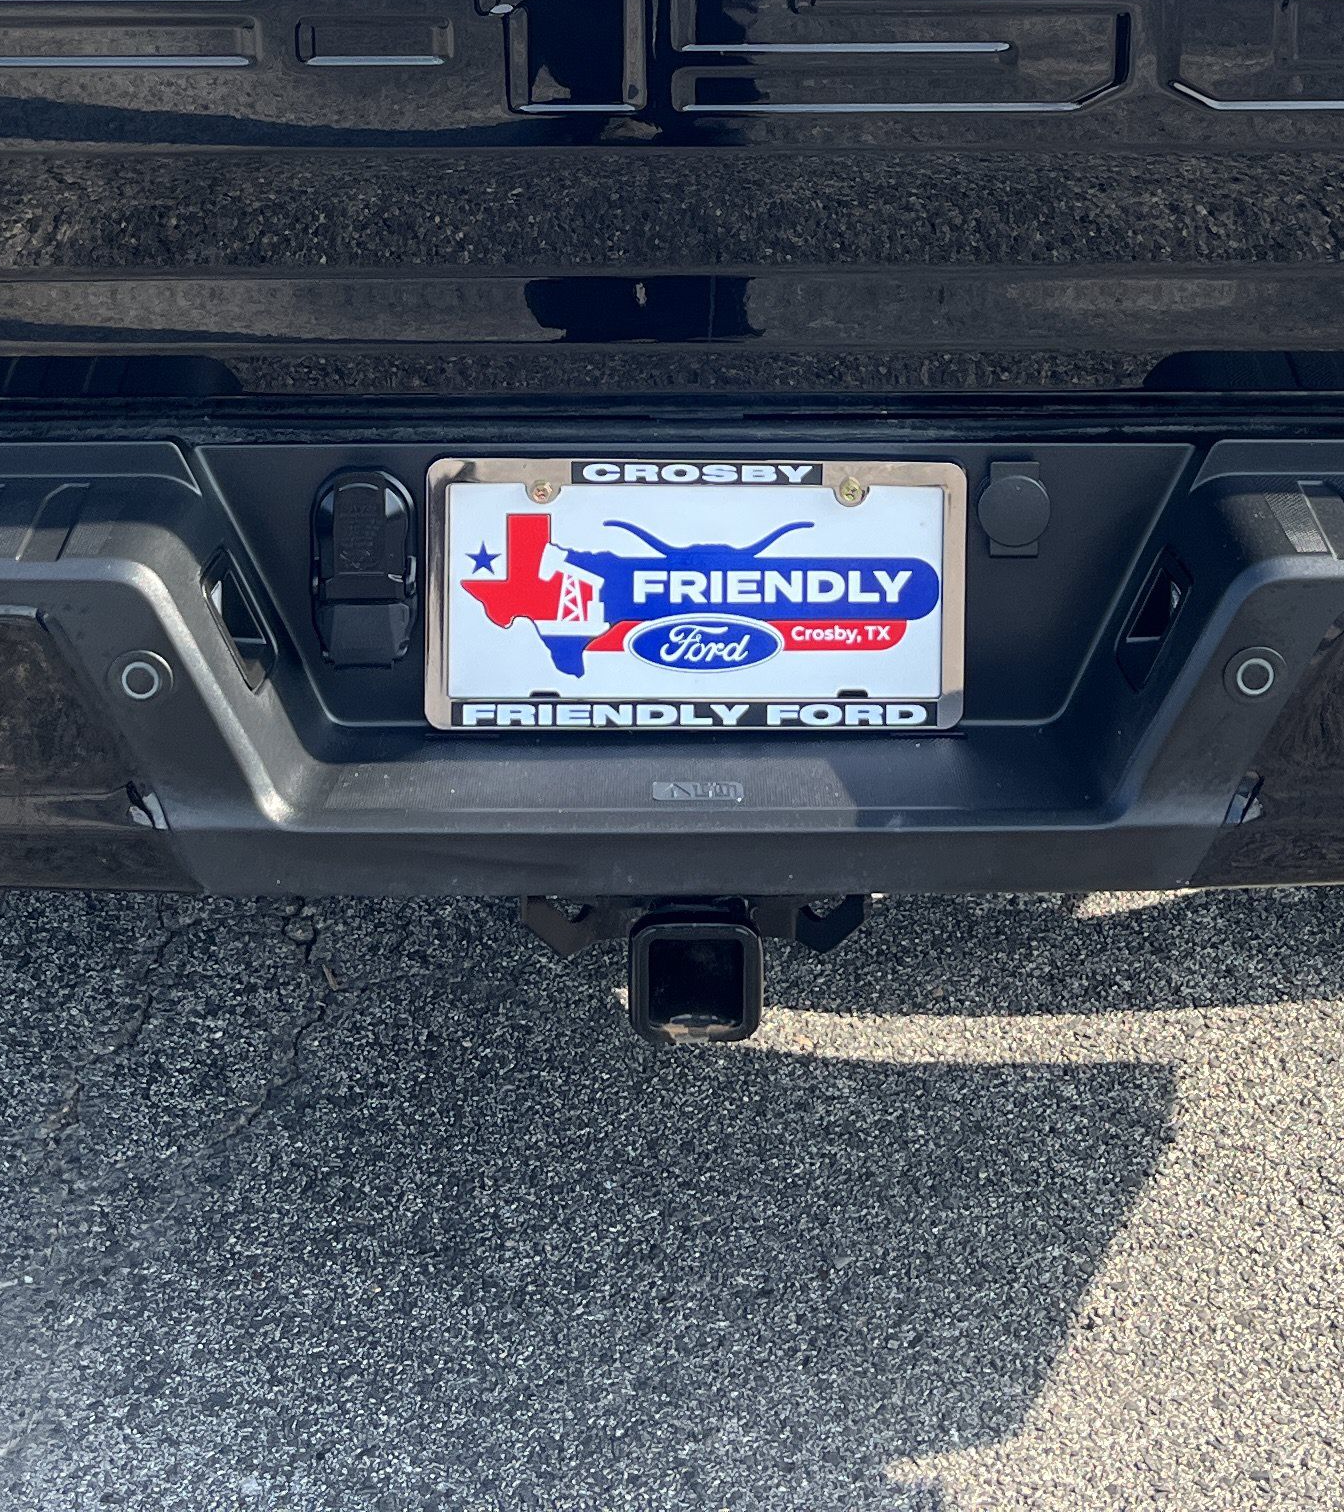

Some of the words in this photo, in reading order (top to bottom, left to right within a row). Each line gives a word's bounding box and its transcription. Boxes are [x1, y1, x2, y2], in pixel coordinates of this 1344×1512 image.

[582, 463, 814, 483] CROSBY
[632, 570, 913, 604] FRIENDLY
[659, 624, 749, 664] Ford
[790, 624, 862, 645] Crosby,
[864, 624, 891, 641] TX
[461, 703, 750, 727] FRIENDLY
[766, 703, 928, 727] FORD
